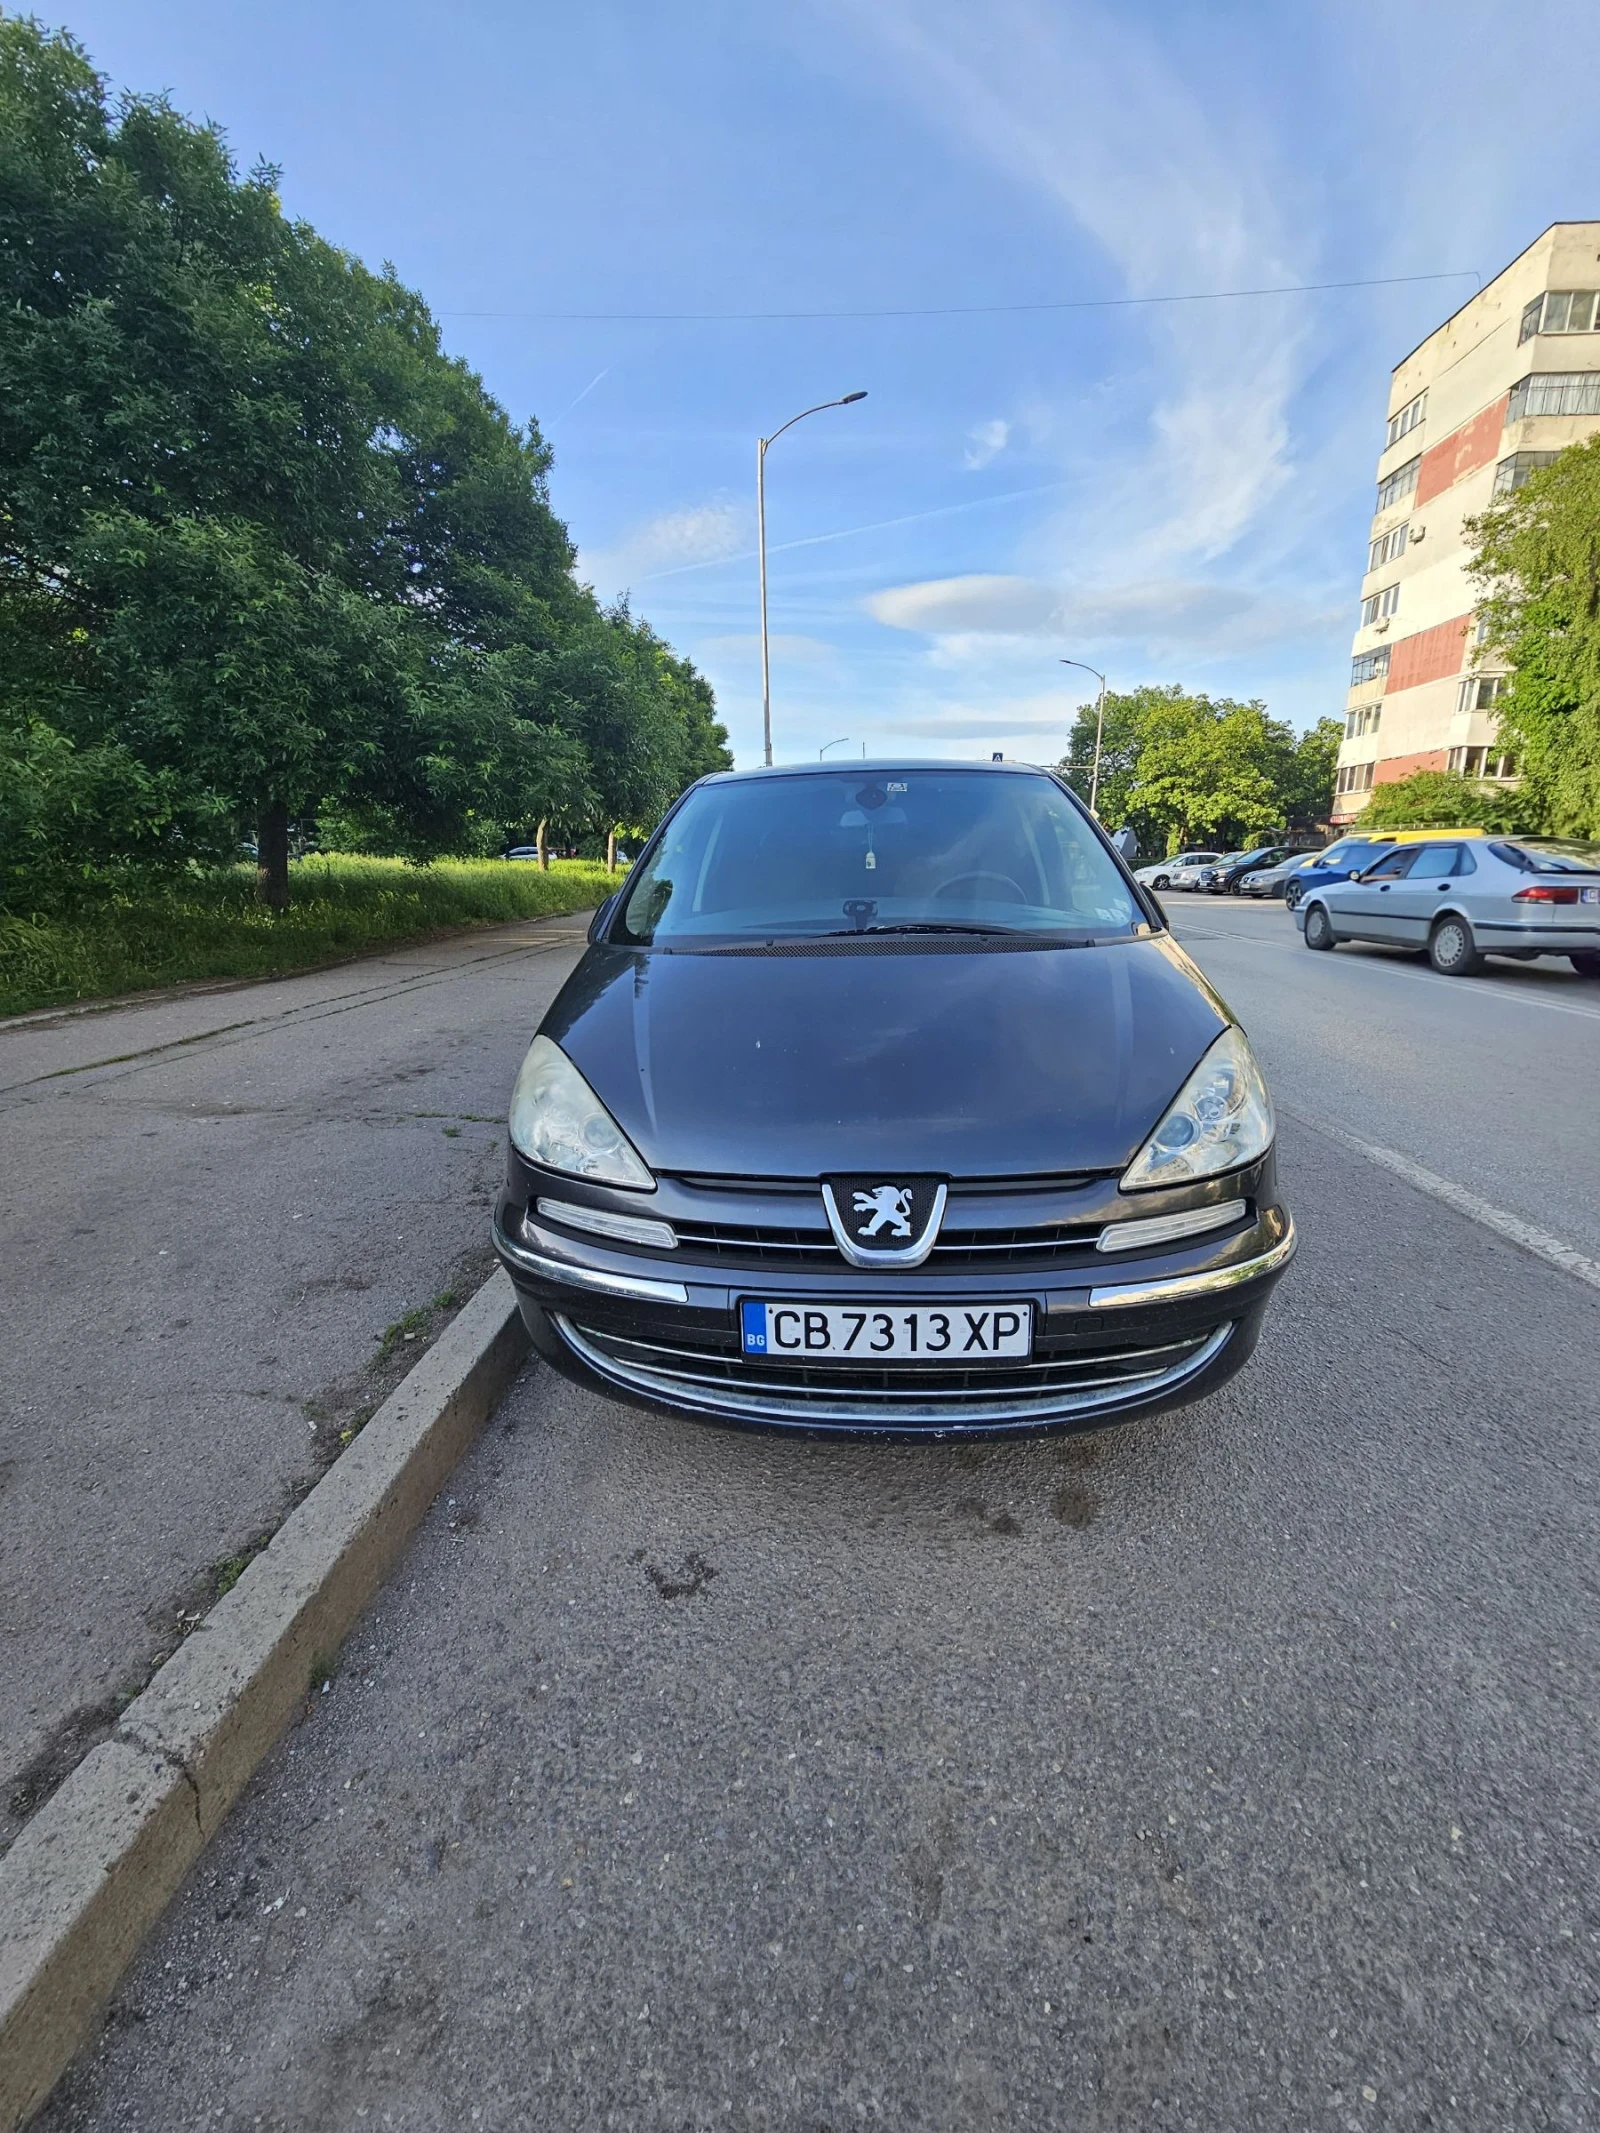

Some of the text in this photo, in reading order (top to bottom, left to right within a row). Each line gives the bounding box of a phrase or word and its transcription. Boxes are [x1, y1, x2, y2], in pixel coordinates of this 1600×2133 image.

[747, 1334, 765, 1346] BG
[774, 1310, 1020, 1351] CB 7313 XP
